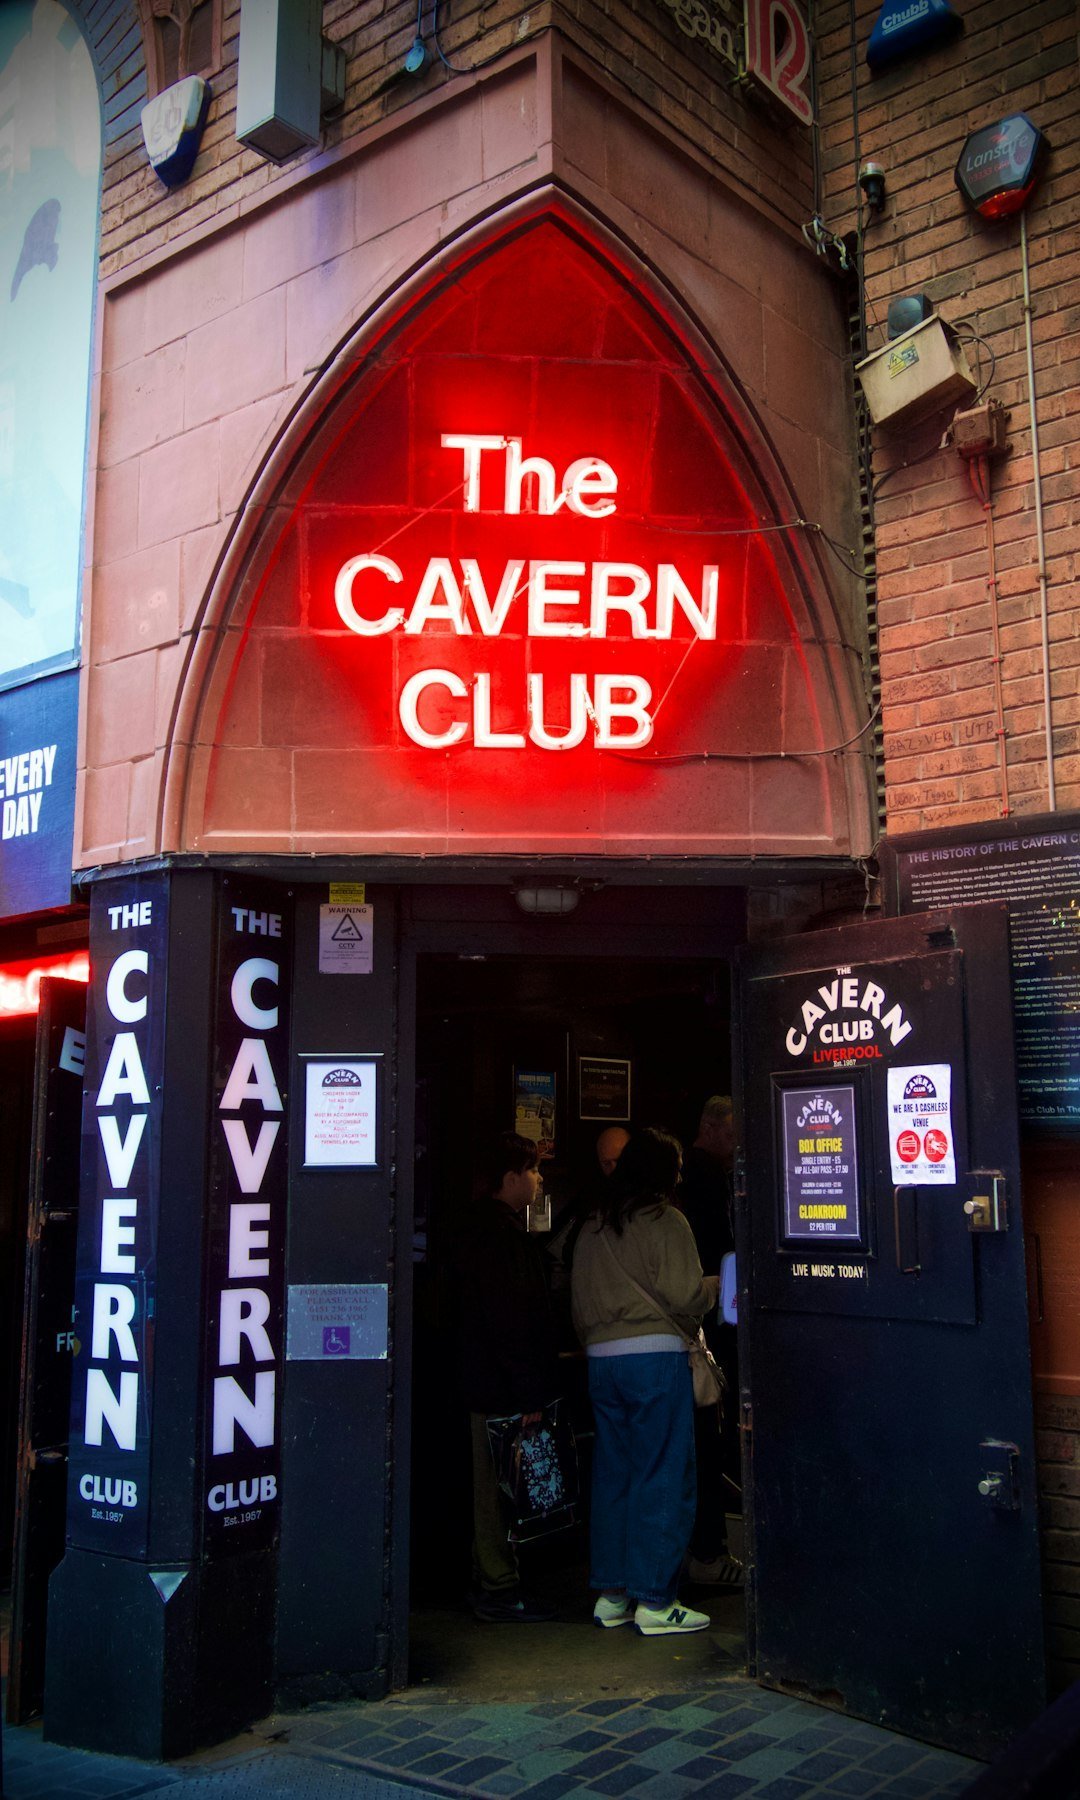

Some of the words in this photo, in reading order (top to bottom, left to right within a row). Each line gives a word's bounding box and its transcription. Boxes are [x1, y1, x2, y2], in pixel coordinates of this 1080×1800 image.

[881, 0, 929, 29] Chubb
[966, 134, 1028, 172] Lansafe
[441, 434, 618, 518] The
[334, 553, 719, 640] CAVERN
[399, 668, 654, 750] CLUB
[2, 791, 43, 840] DAY
[908, 852, 929, 864] THE
[932, 846, 977, 861] HISTORY
[980, 844, 994, 855] OF
[997, 841, 1019, 852] THE
[1021, 834, 1067, 850] CAVERN
[108, 901, 152, 930] THE
[231, 906, 282, 938] THE
[836, 967, 851, 975] THE
[786, 978, 913, 1056] CAVERN
[819, 1020, 874, 1044] CLUB
[813, 1045, 883, 1063] LIVERPOOL
[325, 1071, 359, 1084] CAVERN
[906, 1077, 934, 1094] CAVERN
[797, 1099, 843, 1128] CAVERN
[809, 1115, 830, 1124] CLUB
[893, 1104, 901, 1113] WE
[904, 1104, 913, 1113] ARE
[915, 1103, 918, 1112] A
[920, 1102, 948, 1112] CASHLESS
[912, 1118, 929, 1127] VENUE
[798, 1139, 815, 1153] BOX
[816, 1138, 842, 1152] OFFICE
[794, 1166, 802, 1174] VIP
[802, 1166, 820, 1174] ALL-DAY
[820, 1165, 832, 1174] PASS
[835, 1165, 848, 1173] £7.50
[801, 1156, 816, 1165] SINGLE
[817, 1156, 831, 1165] ENTRY
[834, 1156, 841, 1164] £5
[84, 949, 151, 1451] CAVERN
[212, 957, 284, 1456] CAVERN
[799, 1204, 847, 1219] CLOAKROOM
[809, 1222, 816, 1231] £2
[816, 1222, 824, 1231] PER
[825, 1222, 836, 1231] ITEM
[792, 1263, 808, 1276] LIVE
[811, 1264, 835, 1277] MUSIC
[837, 1266, 864, 1278] TODAY
[79, 1474, 138, 1507] CLUB
[207, 1474, 277, 1512] CLUB
[666, 1609, 687, 1624] N
